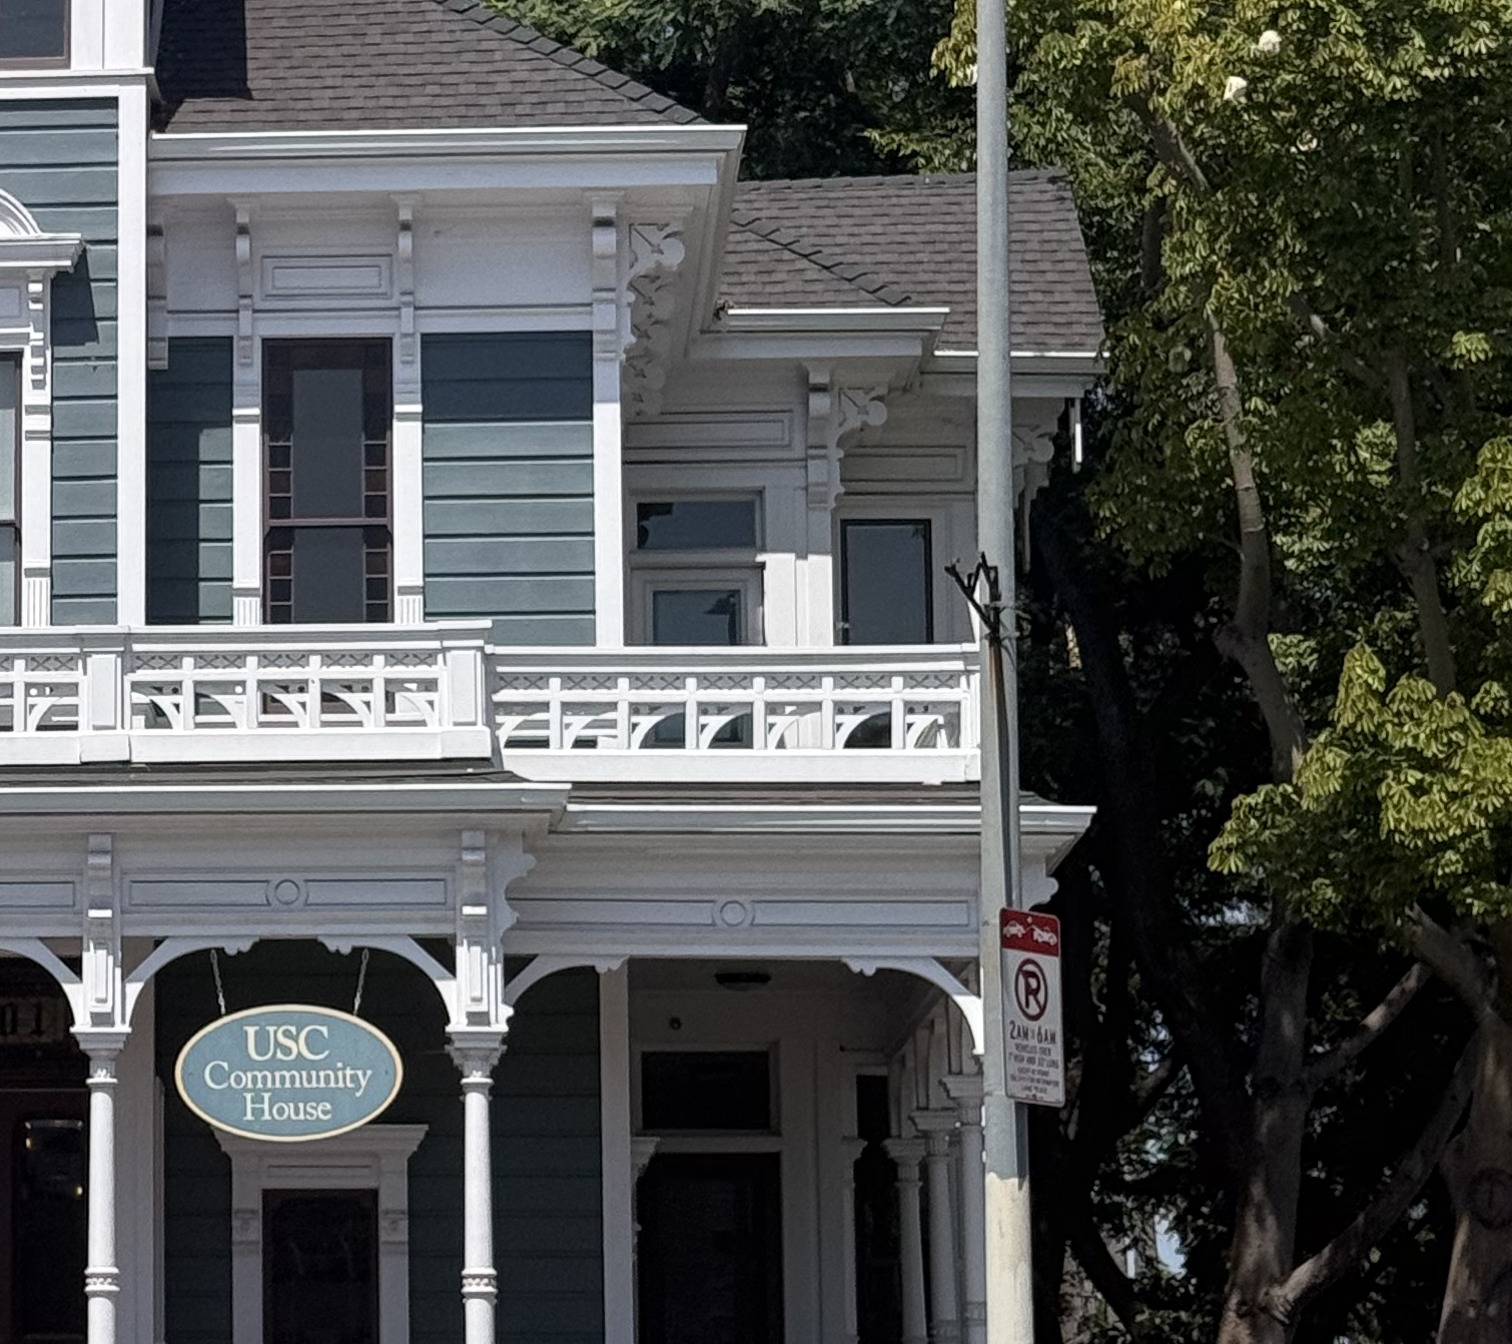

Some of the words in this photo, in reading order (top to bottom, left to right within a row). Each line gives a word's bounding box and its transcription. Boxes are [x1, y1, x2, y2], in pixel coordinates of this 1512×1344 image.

[243, 1024, 330, 1061] USC
[1010, 1020, 1029, 1042] 2AM
[1037, 1026, 1056, 1044] 6AM
[203, 1061, 373, 1098] Community
[242, 1092, 333, 1121] House
